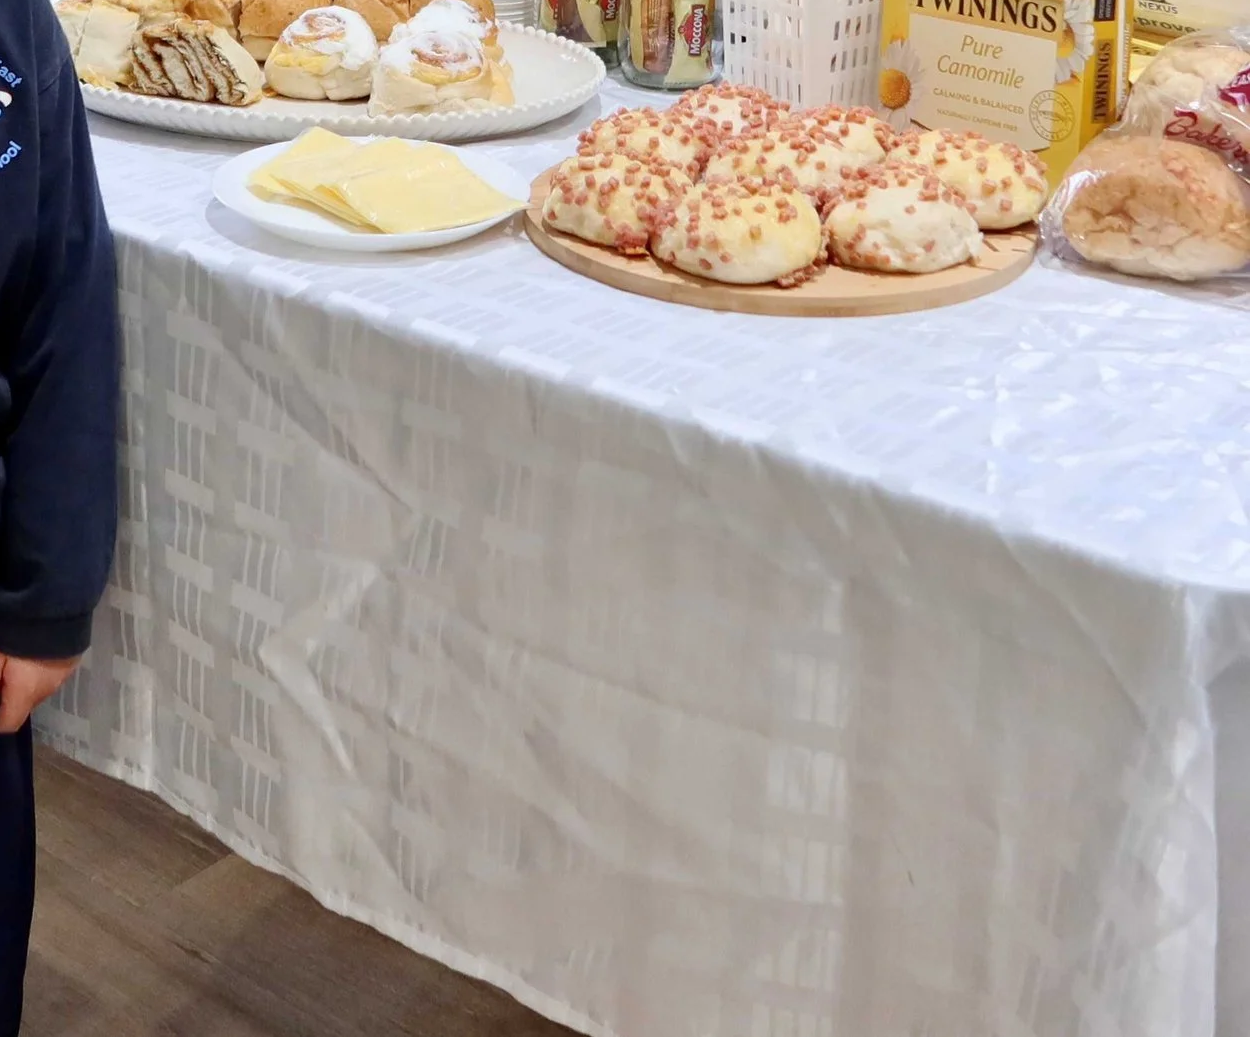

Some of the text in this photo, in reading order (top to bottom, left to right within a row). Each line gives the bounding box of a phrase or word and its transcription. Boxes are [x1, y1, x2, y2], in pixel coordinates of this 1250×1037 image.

[1138, 0, 1179, 15] NEXUS
[689, 7, 704, 56] MOCCONA
[960, 34, 1004, 60] Pure
[937, 55, 1025, 89] Camomile
[1094, 41, 1112, 122] TWININGS
[933, 88, 1025, 115] CALMING & BALANCED
